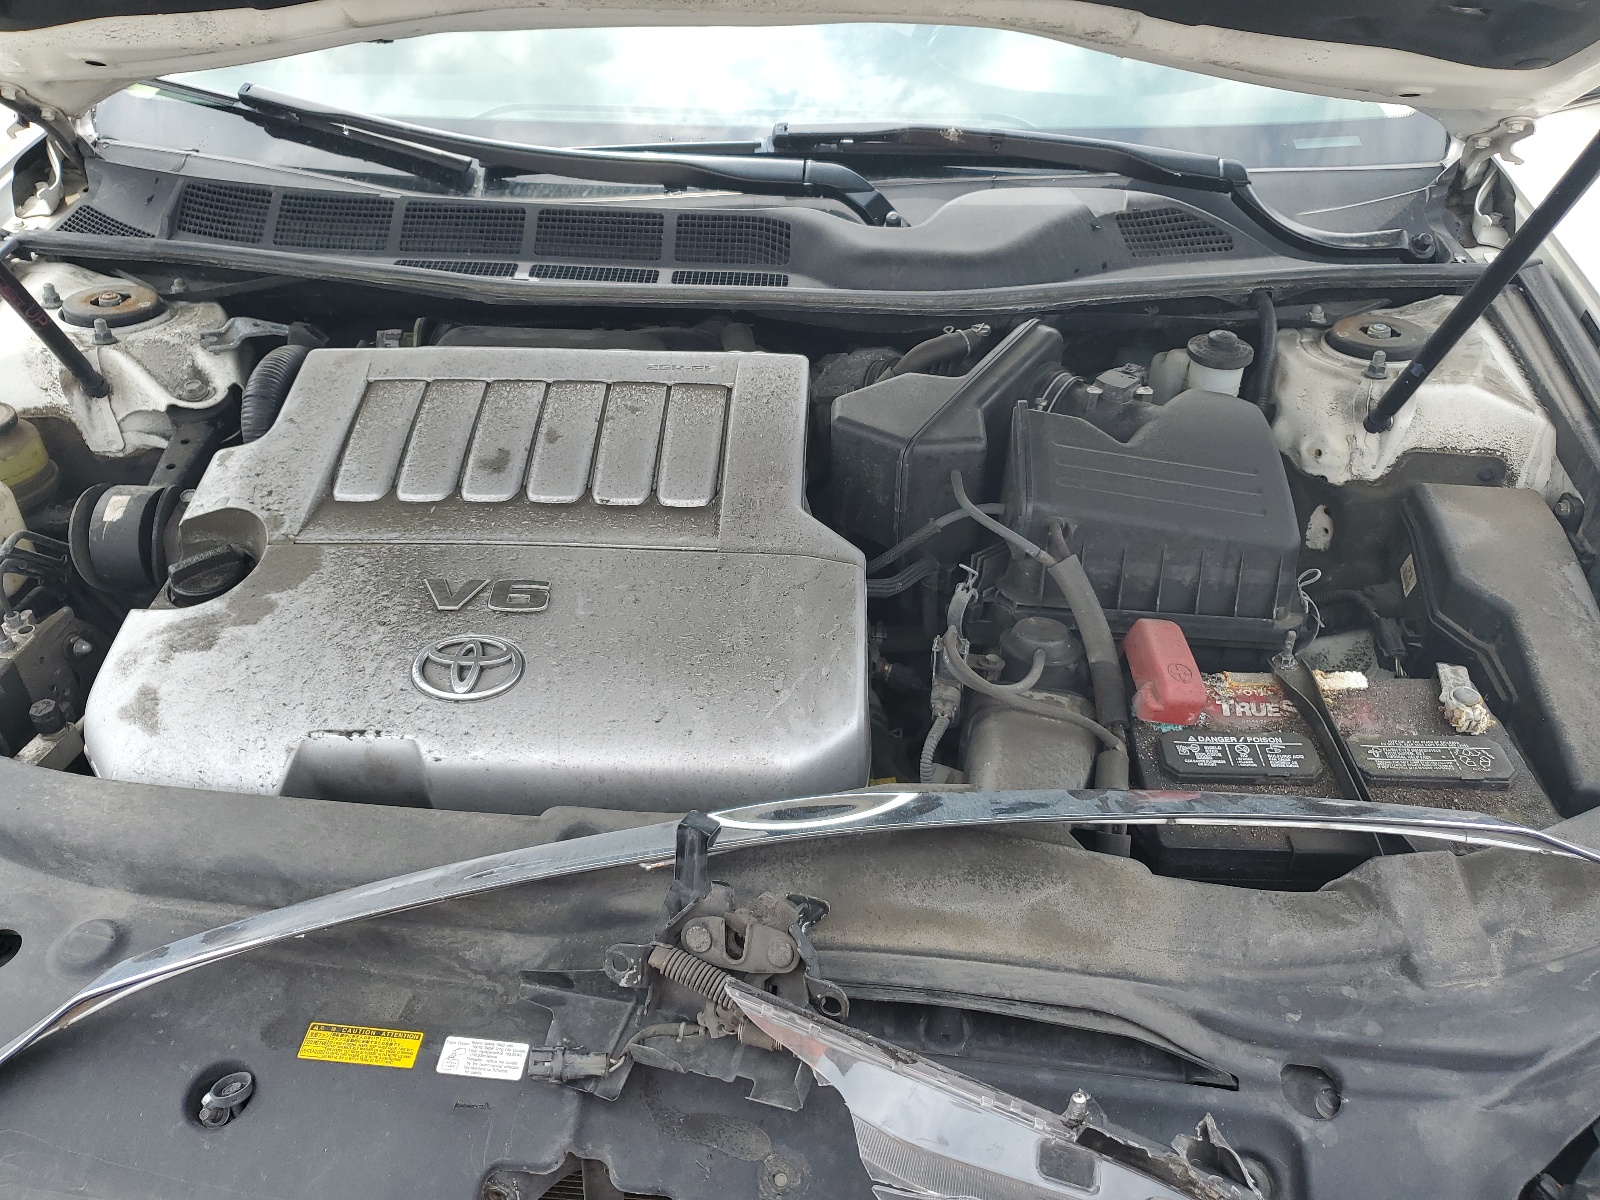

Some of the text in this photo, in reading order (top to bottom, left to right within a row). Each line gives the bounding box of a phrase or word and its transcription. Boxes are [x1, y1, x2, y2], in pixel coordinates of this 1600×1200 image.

[424, 578, 552, 613] V6
[341, 1027, 376, 1036] CAUTION
[381, 1031, 420, 1040] ATTENTION
